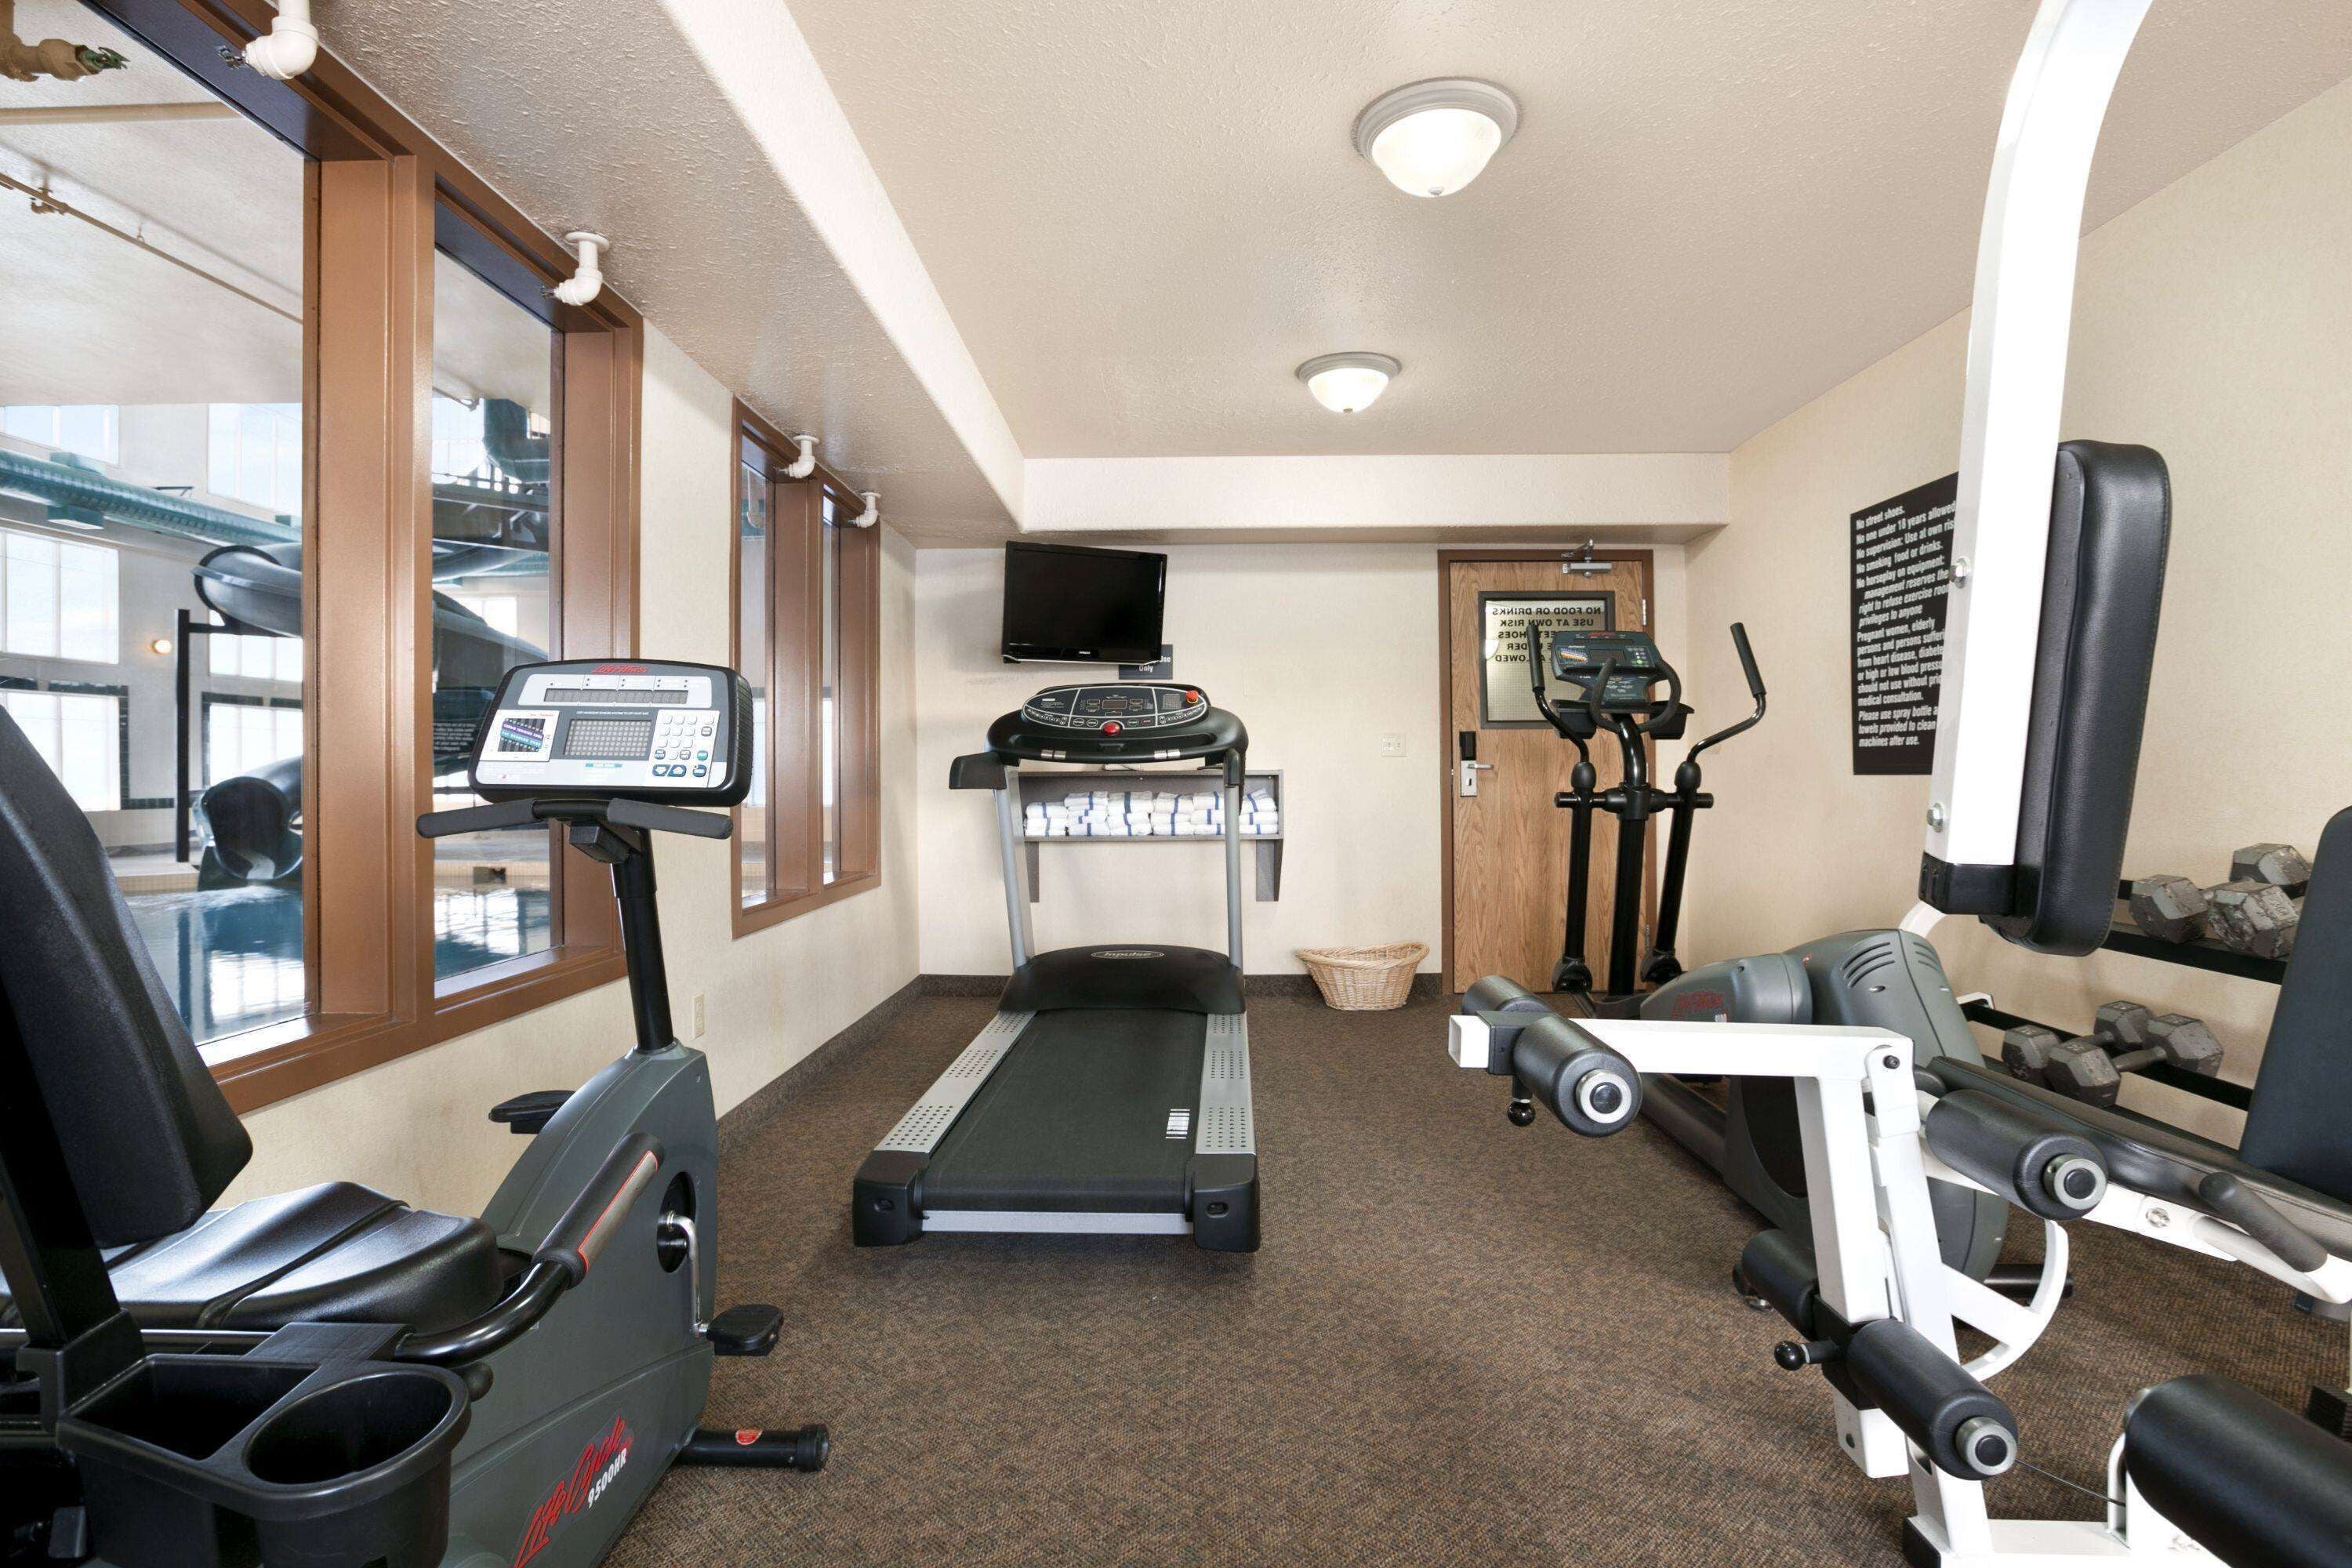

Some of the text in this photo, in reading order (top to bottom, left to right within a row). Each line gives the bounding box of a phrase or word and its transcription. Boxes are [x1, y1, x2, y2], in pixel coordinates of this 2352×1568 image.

[1856, 506, 1905, 530] No street shoes.
[1856, 534, 1864, 545] No
[1865, 531, 1877, 542] one
[1878, 524, 1896, 537] under
[1907, 513, 1926, 529] years
[1856, 549, 1864, 560] No
[1904, 532, 1918, 544] Use
[1919, 527, 1926, 539] at
[1928, 524, 1943, 536] own
[1944, 519, 1955, 532] ris
[1856, 564, 1864, 574] No
[1865, 556, 1892, 571] smoking
[1894, 549, 1909, 564] food
[1910, 548, 1918, 558] or
[1856, 578, 1864, 589] No
[1866, 570, 1896, 586] horseplay
[1897, 567, 1906, 578] on
[1864, 568, 1949, 599] management reserves the
[1858, 584, 1949, 615] right to refuse exercise roo
[1857, 617, 1936, 643] Pregnant women, elderly
[1858, 612, 1889, 630] privileges
[1890, 609, 1897, 620] to
[1857, 629, 1944, 657] persons and persons sufferi
[1857, 644, 1944, 668] from heart disease, diabete
[1857, 660, 1942, 682] or high or low blood pressu
[1857, 673, 1942, 694] should not use without prio
[1857, 690, 1924, 706] medical consultation.
[1858, 710, 1879, 721] Please
[1880, 710, 1892, 720] use
[1893, 709, 1911, 720] spray
[1912, 705, 1932, 717] bottle
[1858, 719, 1936, 735] towels provided to clean
[1859, 735, 1920, 747] machines after use.
[588, 1447, 627, 1509] 9500HR
